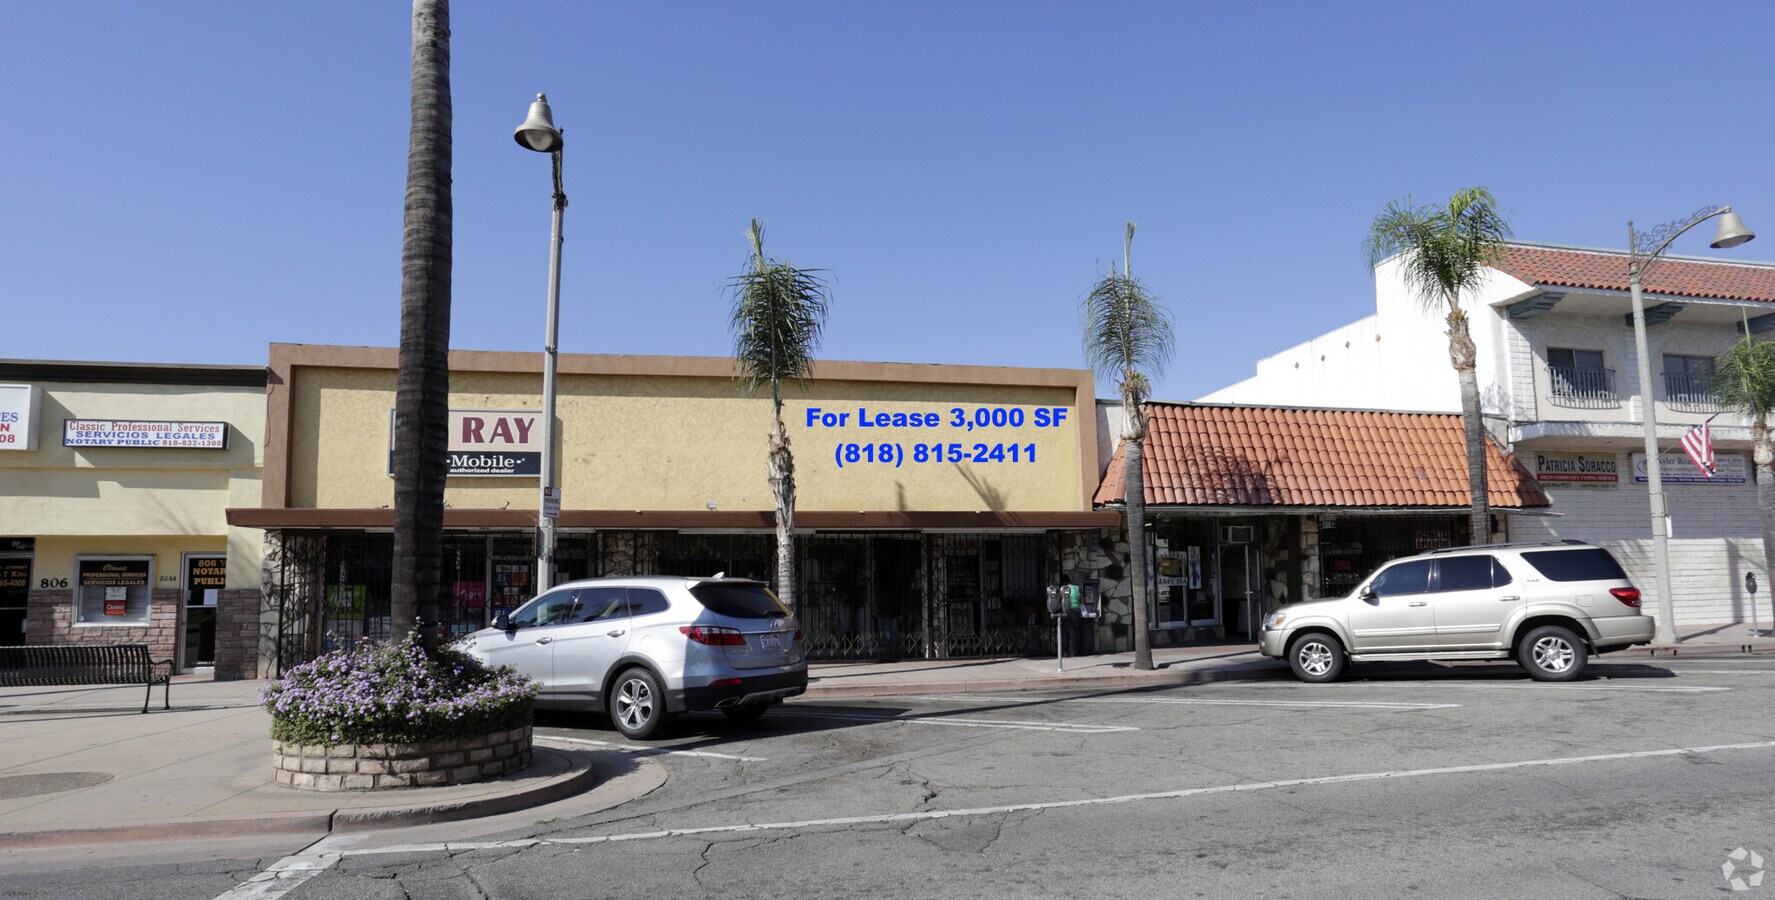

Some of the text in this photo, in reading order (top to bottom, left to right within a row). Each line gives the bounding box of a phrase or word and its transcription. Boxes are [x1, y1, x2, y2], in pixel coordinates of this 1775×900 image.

[0, 411, 19, 422] ES
[69, 420, 220, 433] Classic Professional Services
[462, 417, 535, 444] RAY
[76, 430, 216, 440] SERVICIOS LEGALES
[1538, 455, 1616, 473] PATRICIA SORACCO
[198, 560, 217, 568] 806
[41, 578, 68, 588] 806
